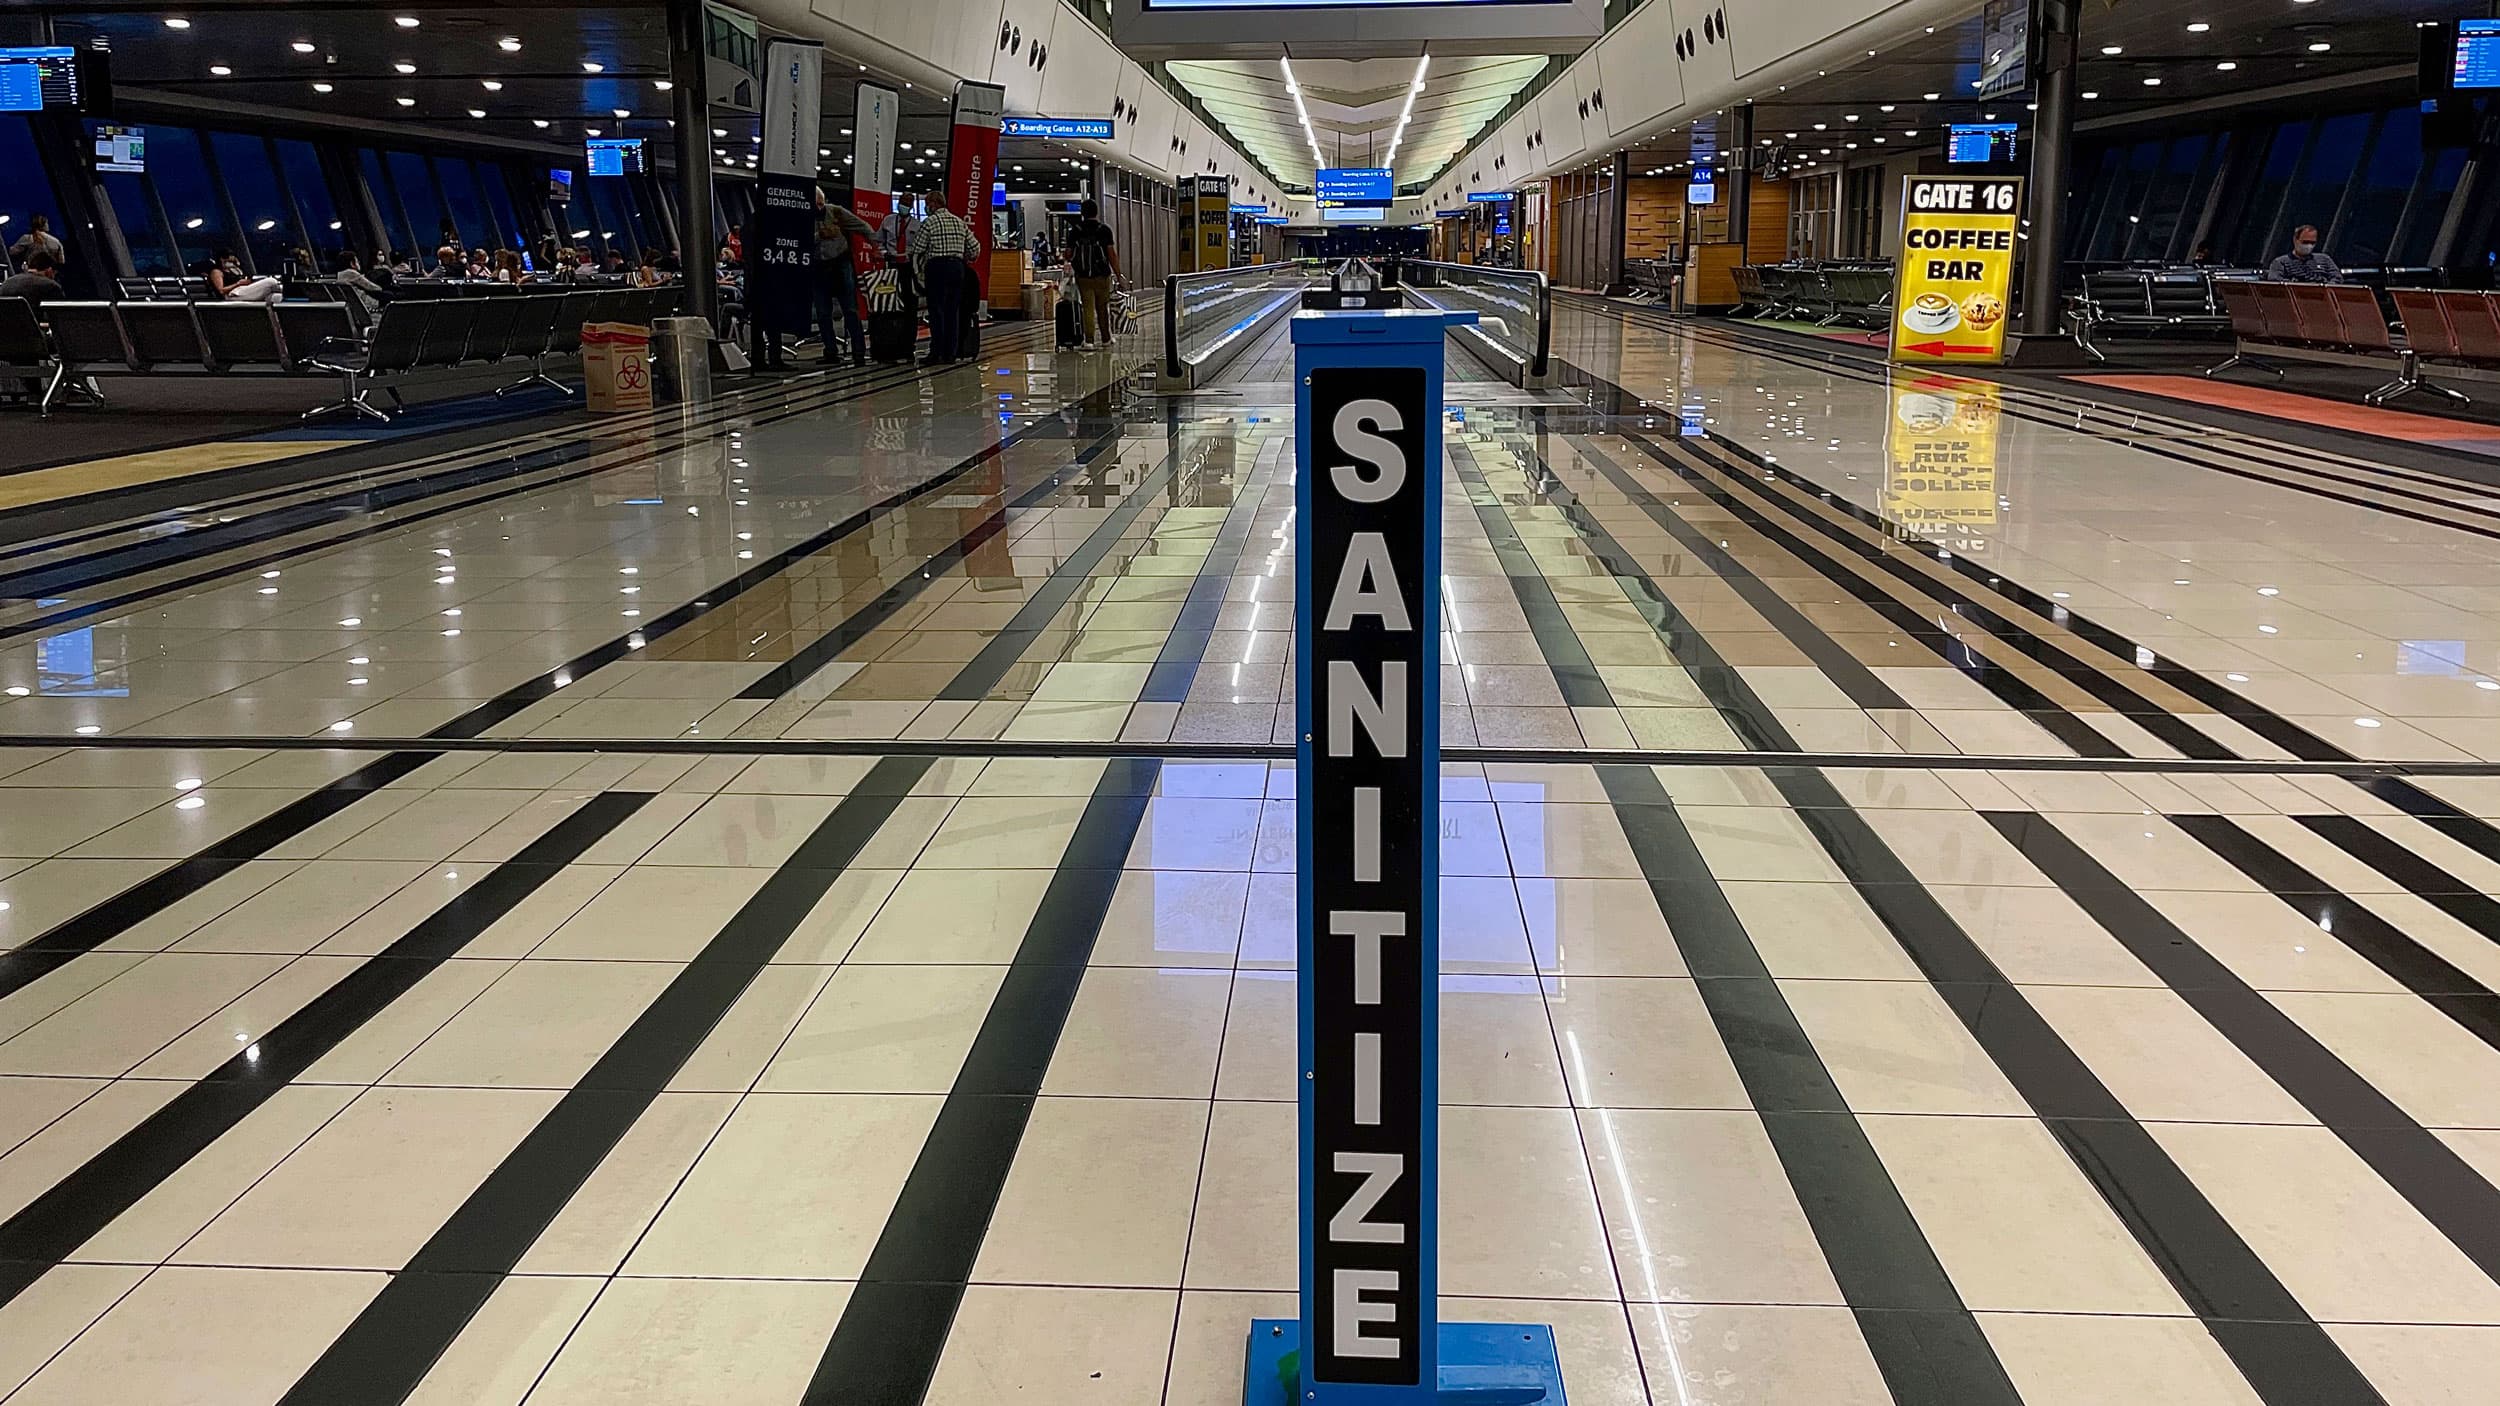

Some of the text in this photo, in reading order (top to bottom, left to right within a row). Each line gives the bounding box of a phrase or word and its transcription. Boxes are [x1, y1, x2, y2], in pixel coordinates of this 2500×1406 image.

[1020, 123, 1108, 134] Boarding Gates A12-A13
[1694, 171, 1711, 180] A14
[1199, 180, 1218, 193] GATE
[767, 187, 806, 200] GENERAL
[1914, 183, 2014, 210] GATE 16
[766, 197, 811, 210] BOARDING
[775, 237, 799, 248] ZONE
[1906, 228, 2011, 250] COFFEE
[763, 247, 811, 266] 3,4 & 5
[1927, 260, 1984, 281] BAR
[1323, 398, 1413, 1359] SANITIZE
